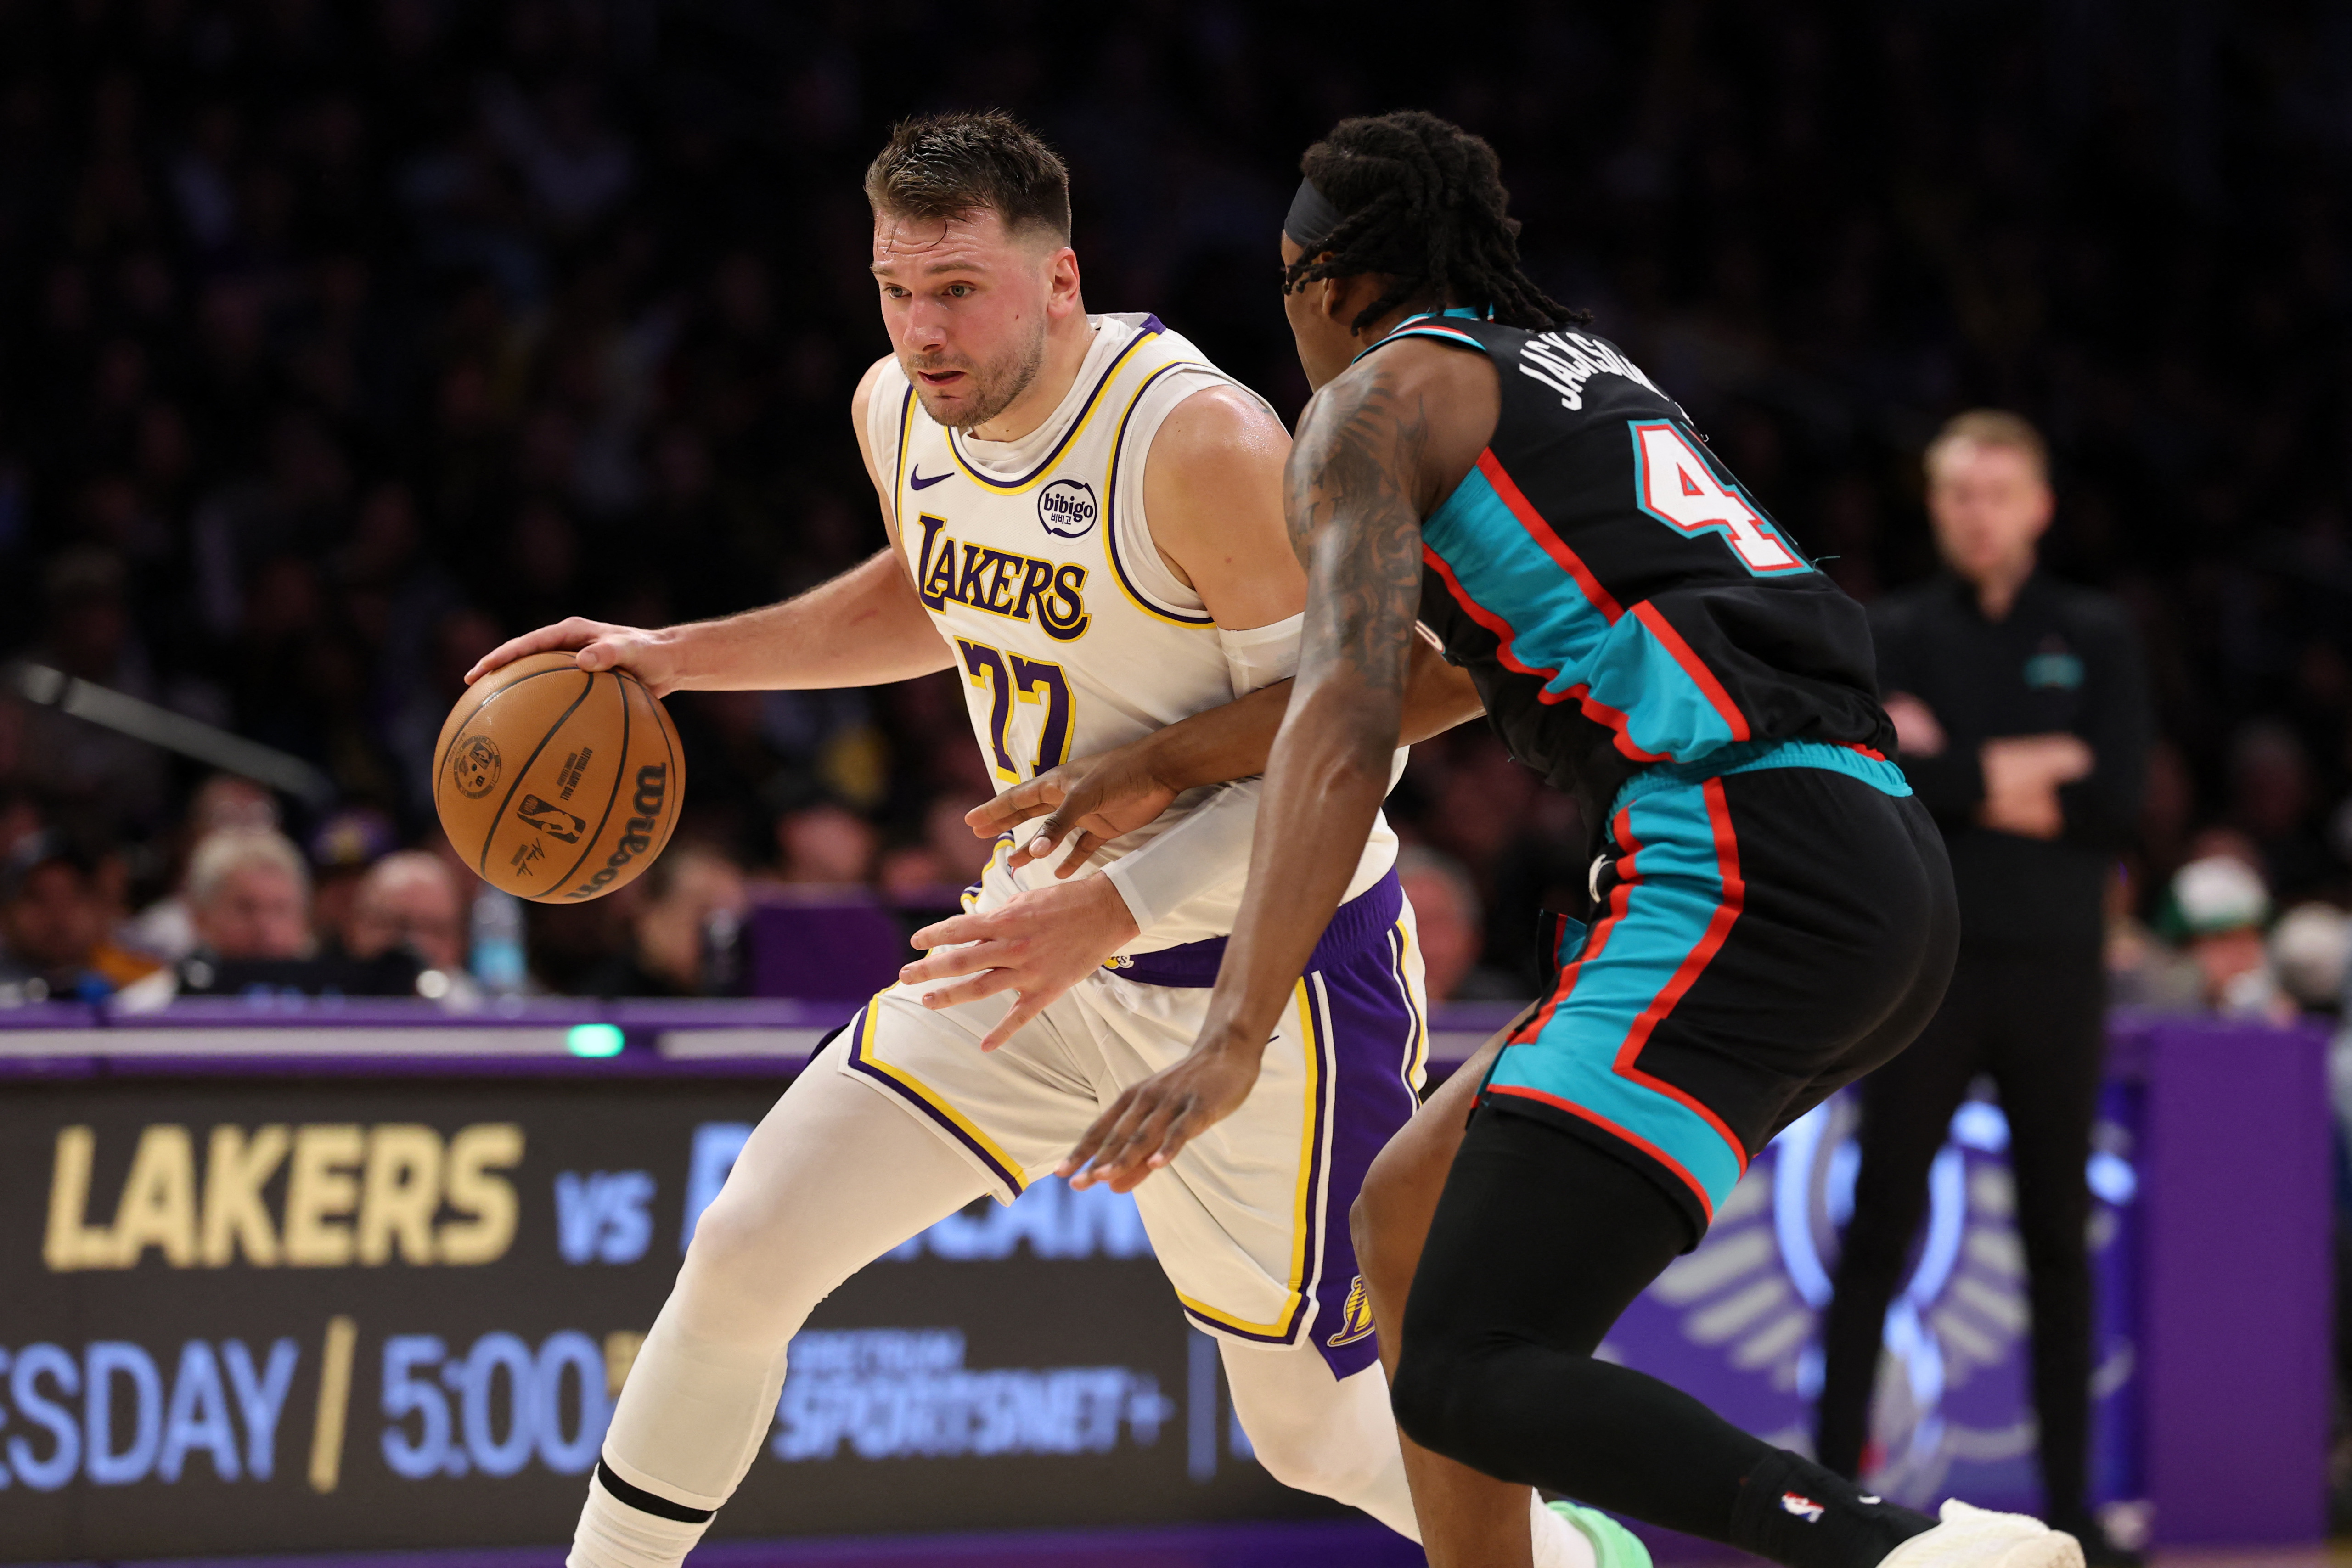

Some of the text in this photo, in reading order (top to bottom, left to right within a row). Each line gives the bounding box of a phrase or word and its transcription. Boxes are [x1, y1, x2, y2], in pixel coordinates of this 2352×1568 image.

[1044, 493, 1093, 523] bibigo
[1051, 513, 1071, 525] 비비고
[1627, 418, 1813, 577] 4
[917, 511, 1091, 643] LAKERS
[952, 635, 1076, 784] 77
[563, 762, 666, 899] Wilson
[42, 1123, 524, 1272] LAKERS
[0, 1337, 300, 1490] SDAY
[380, 1329, 613, 1478] 5:00
